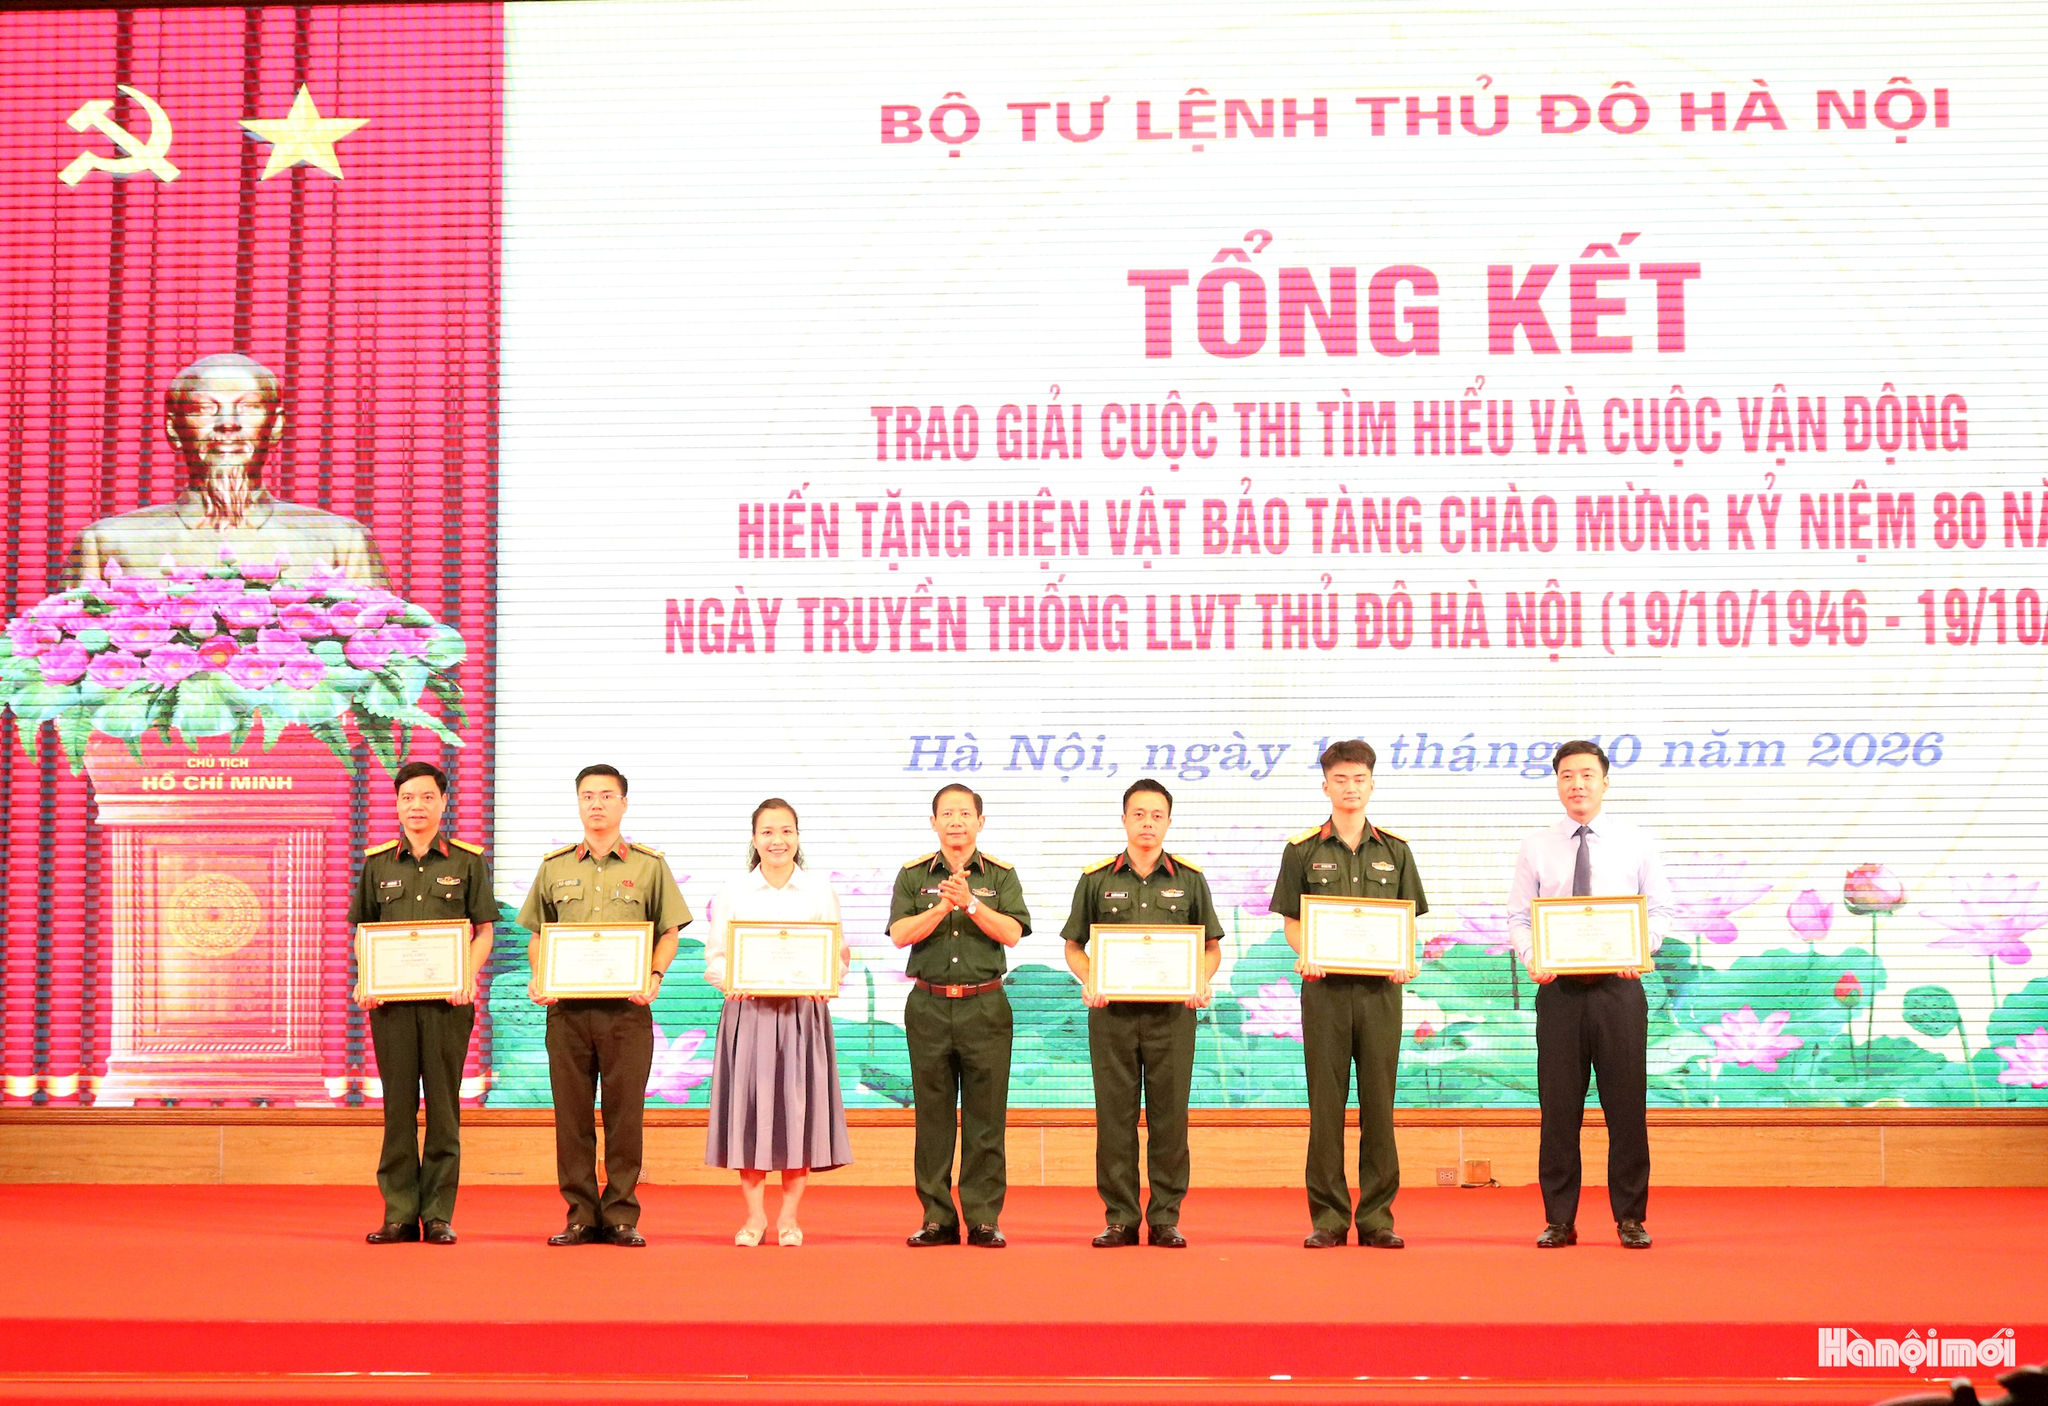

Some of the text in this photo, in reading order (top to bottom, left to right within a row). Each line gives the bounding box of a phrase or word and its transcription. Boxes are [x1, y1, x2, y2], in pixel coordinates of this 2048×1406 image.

[881, 74, 1950, 157] BỘ TƯ LỆNH THỦ ĐÔ HÀ NỘI
[1128, 229, 1701, 358] TỔNG KẾT
[871, 375, 1968, 471] TRAO GIẢI CUỘC THI TÌM HIỂU VÀ CUỘC VẬN ĐỘNG
[738, 483, 839, 558] HIẾN
[856, 489, 970, 570] TẶNG
[988, 487, 1089, 569] HIỆN
[1106, 487, 1186, 568] VẬT
[1203, 477, 1290, 554] BẢO
[1306, 485, 1422, 553] TÀNG
[1440, 483, 1558, 553] CHÀO
[1576, 482, 1710, 551] MỪNG
[1728, 472, 1783, 549] KỶ
[1801, 480, 1916, 562] NIỆM
[1934, 491, 1987, 549] 80
[665, 586, 782, 654] NGÀY
[797, 578, 967, 653] TRUYỀN
[983, 575, 1128, 652] THỐNG
[1146, 593, 1241, 650] LLVT
[1256, 574, 1339, 649] THỦ
[1354, 580, 1414, 648] ĐÔ
[1431, 580, 1490, 648] HÀ
[1507, 579, 1582, 661] NỘI
[1602, 588, 1868, 654] (19/10/1946
[1886, 616, 1901, 628] -
[142, 771, 293, 790] HỒ CHÍ MINH
[187, 755, 249, 770] CHỦ TỊCH
[904, 733, 983, 772] Hà
[1004, 732, 1119, 782] Nội,
[1144, 731, 1291, 781] ngày
[1390, 733, 1562, 779] tháng
[1658, 730, 1786, 768] năm
[1808, 732, 1945, 767] 2026
